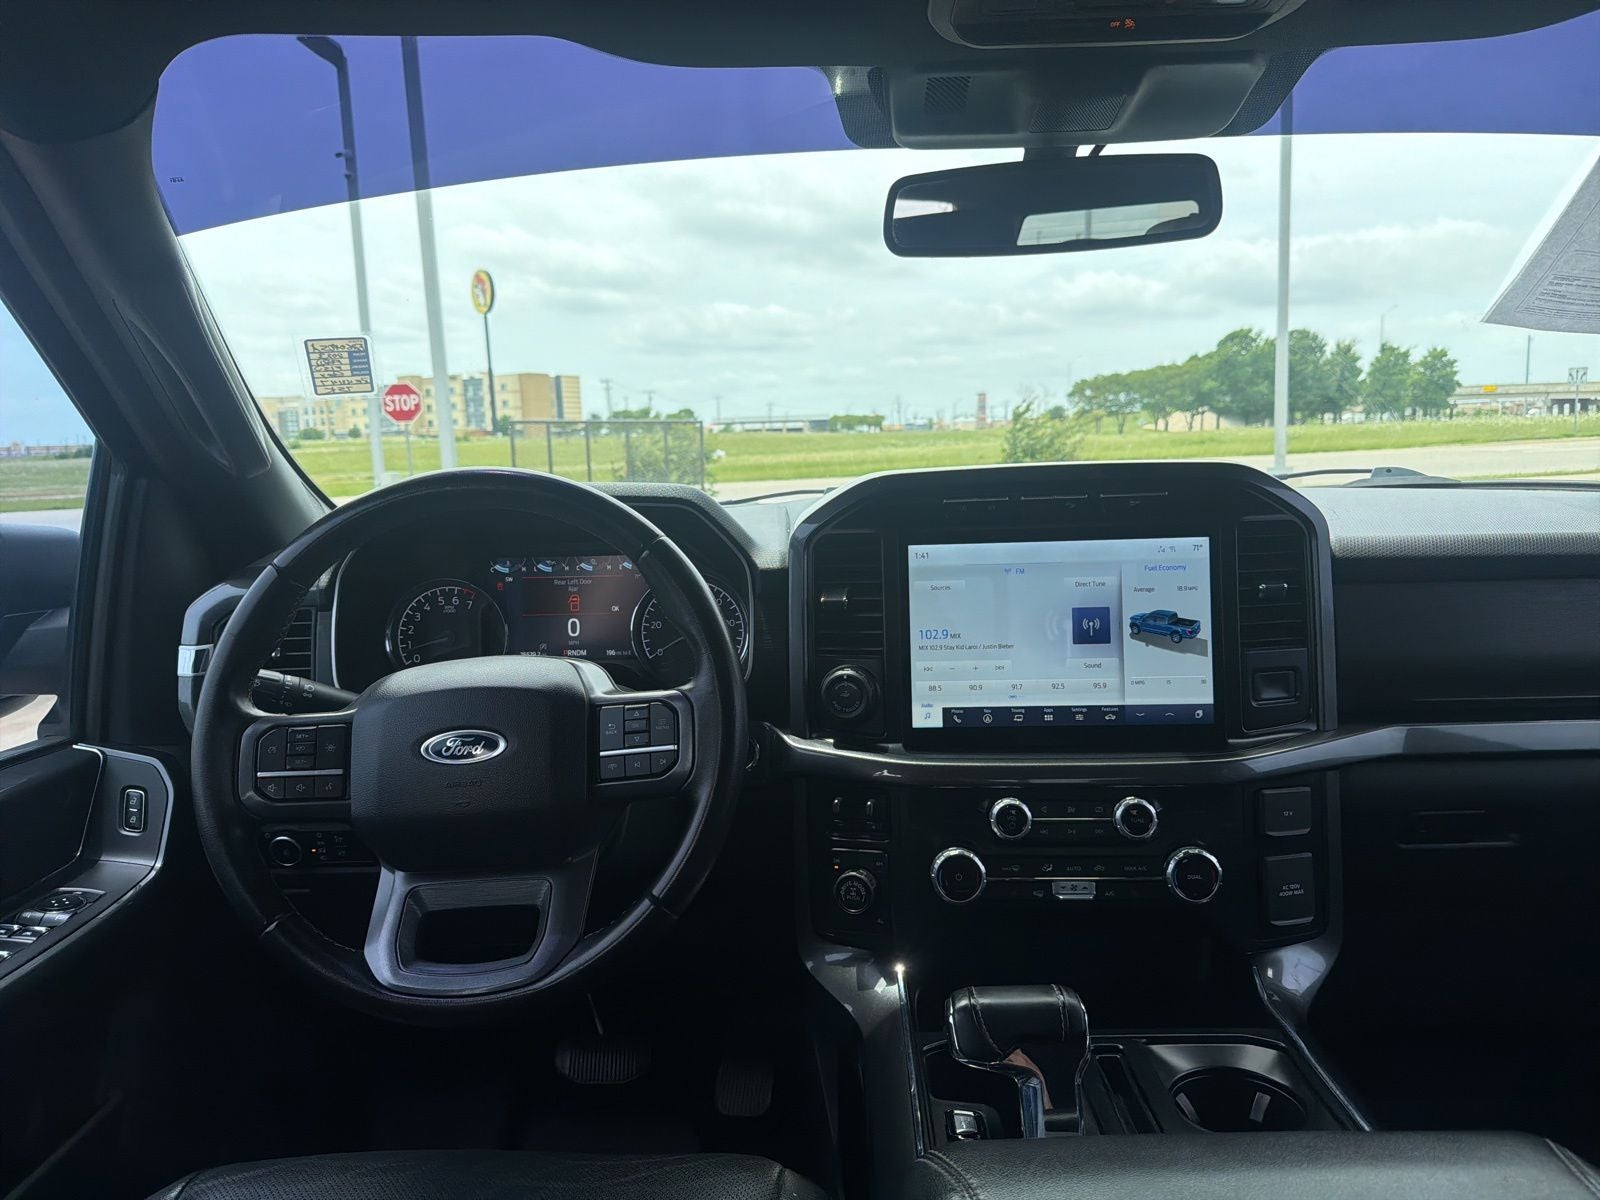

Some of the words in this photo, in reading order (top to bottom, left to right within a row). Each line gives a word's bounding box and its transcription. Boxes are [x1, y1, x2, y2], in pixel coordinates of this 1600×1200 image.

[385, 394, 419, 412] STOP
[1158, 564, 1187, 572] Economy
[438, 596, 445, 605] 5
[452, 596, 459, 605] 6
[467, 600, 473, 610] 7
[423, 603, 431, 611] 4
[414, 612, 421, 621] 3
[408, 625, 415, 634] 2
[567, 617, 580, 637] 0
[651, 621, 662, 629] 20
[919, 629, 949, 640] 102.9
[408, 641, 412, 649] 1
[657, 648, 664, 656] 0
[413, 654, 420, 663] 0
[1011, 683, 1023, 691] 91.7
[441, 737, 484, 757] Ford
